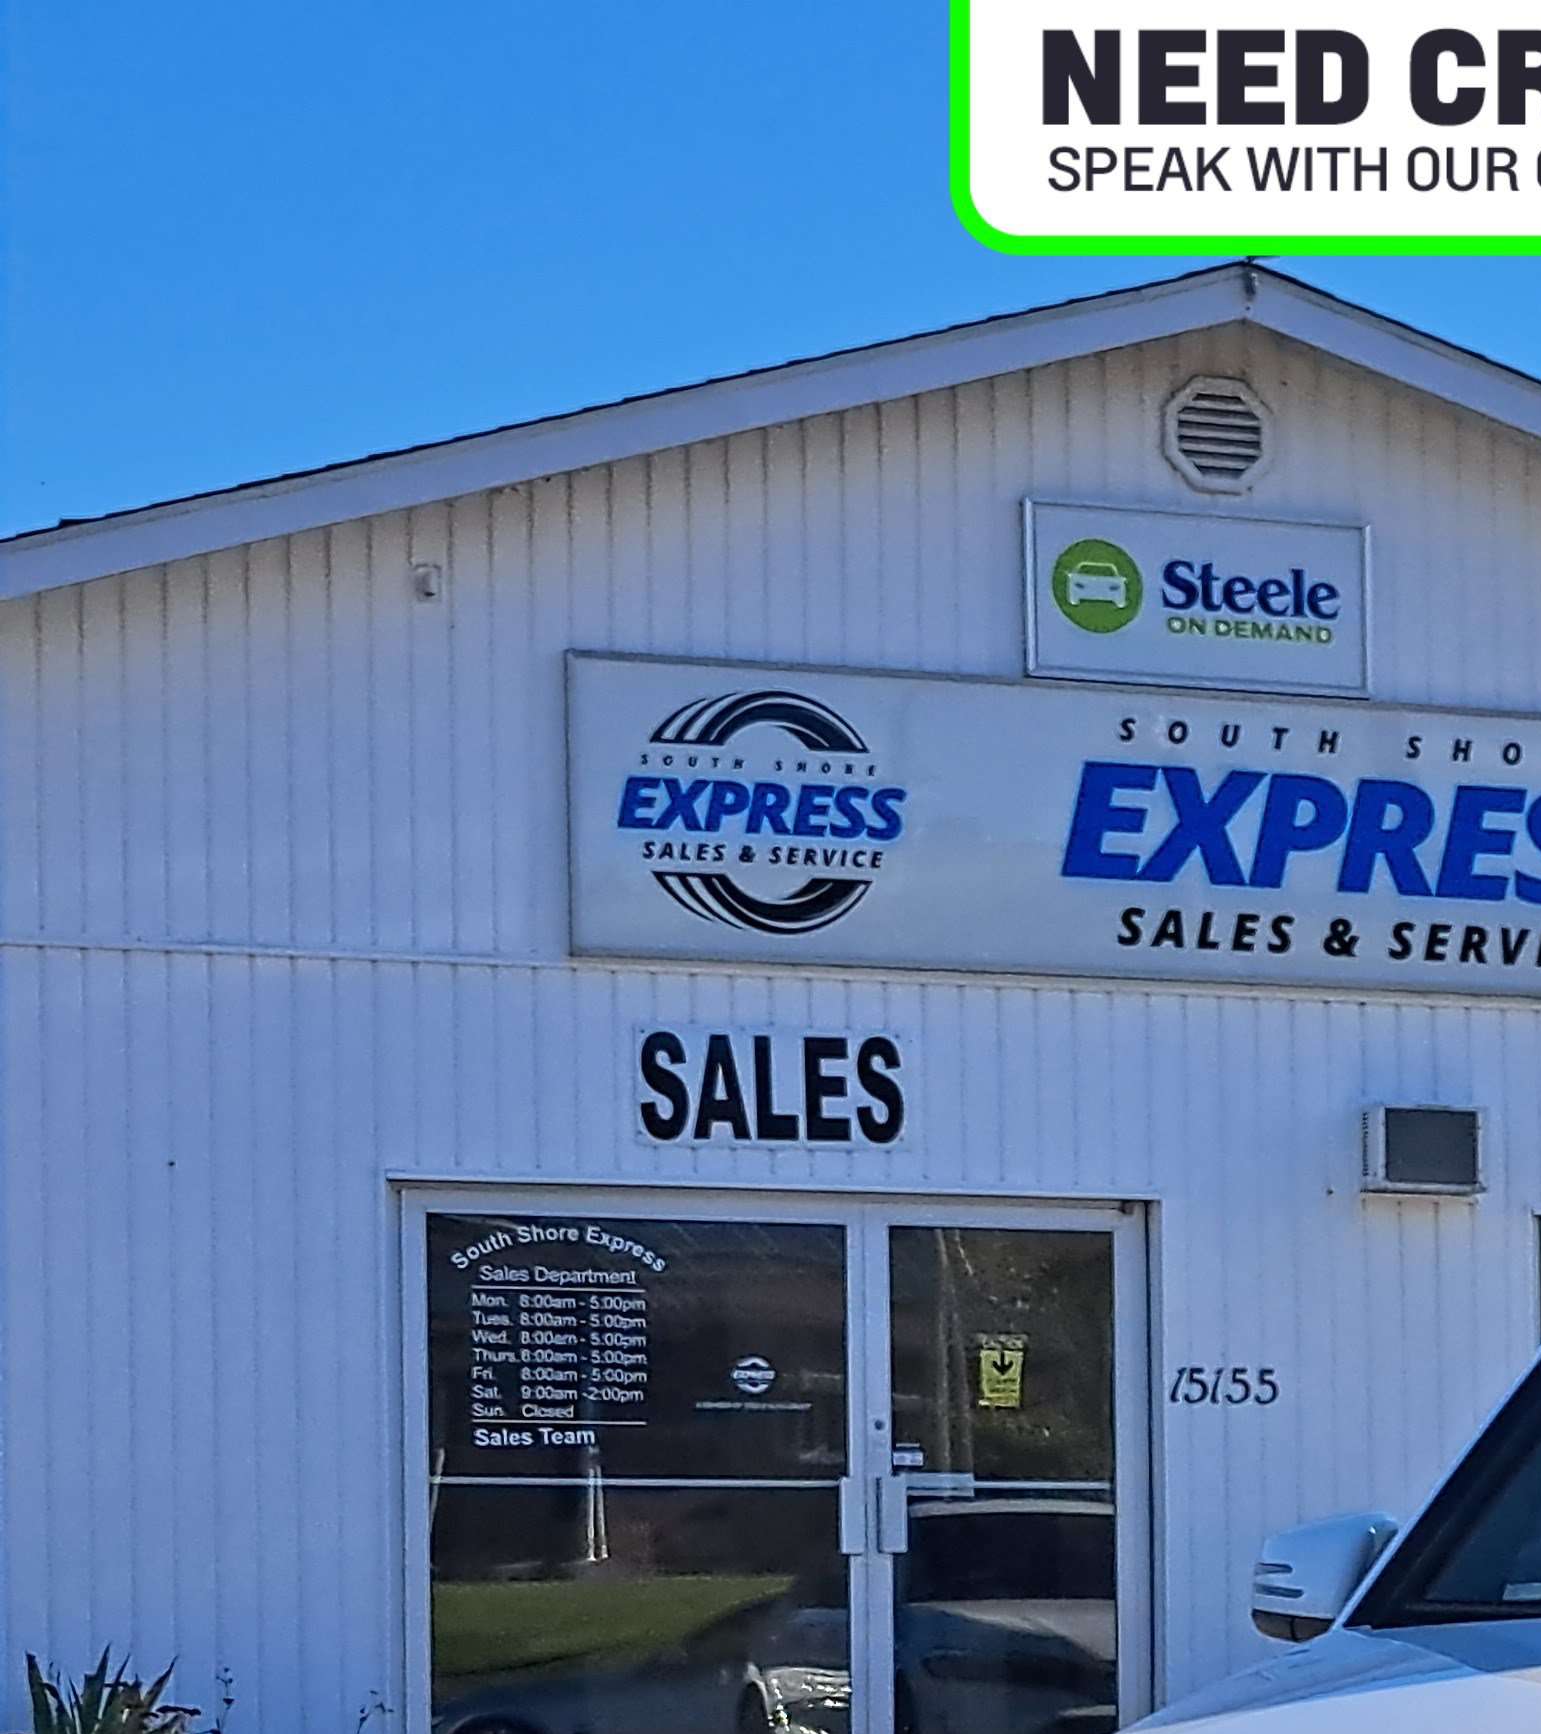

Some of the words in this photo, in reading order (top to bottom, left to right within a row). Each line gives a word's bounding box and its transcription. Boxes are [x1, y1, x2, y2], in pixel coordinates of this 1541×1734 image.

[1161, 559, 1340, 620] Steele
[1167, 616, 1206, 636] ON
[1215, 620, 1333, 644] DEMAND
[1119, 716, 1340, 755] SOUTH
[640, 754, 745, 770] SOUTH
[774, 760, 878, 778] SHORE
[617, 776, 907, 841] EXPRESS
[642, 841, 727, 863] SALES
[738, 845, 756, 863] &
[768, 846, 885, 869] SERVICE
[1117, 906, 1294, 955] SALES
[1323, 917, 1358, 958] &
[640, 1031, 905, 1144] SALES
[450, 1231, 514, 1269] South
[517, 1224, 580, 1243] Shore
[585, 1225, 667, 1272] Express
[479, 1265, 530, 1282] Sales
[534, 1266, 637, 1285] Department
[519, 1294, 576, 1309] 8:00am
[589, 1295, 647, 1312] 5:00pm
[519, 1312, 577, 1327] 8:00am
[590, 1313, 647, 1330] 5:00pm
[520, 1331, 577, 1345] 8:00am
[590, 1332, 647, 1349] 5:00pm
[520, 1367, 578, 1382] 8:00am
[591, 1368, 648, 1385] 5:00pm
[1169, 1367, 1279, 1404] 15155
[521, 1403, 575, 1418] Closed
[473, 1427, 534, 1447] Sales
[538, 1427, 596, 1445] Team
